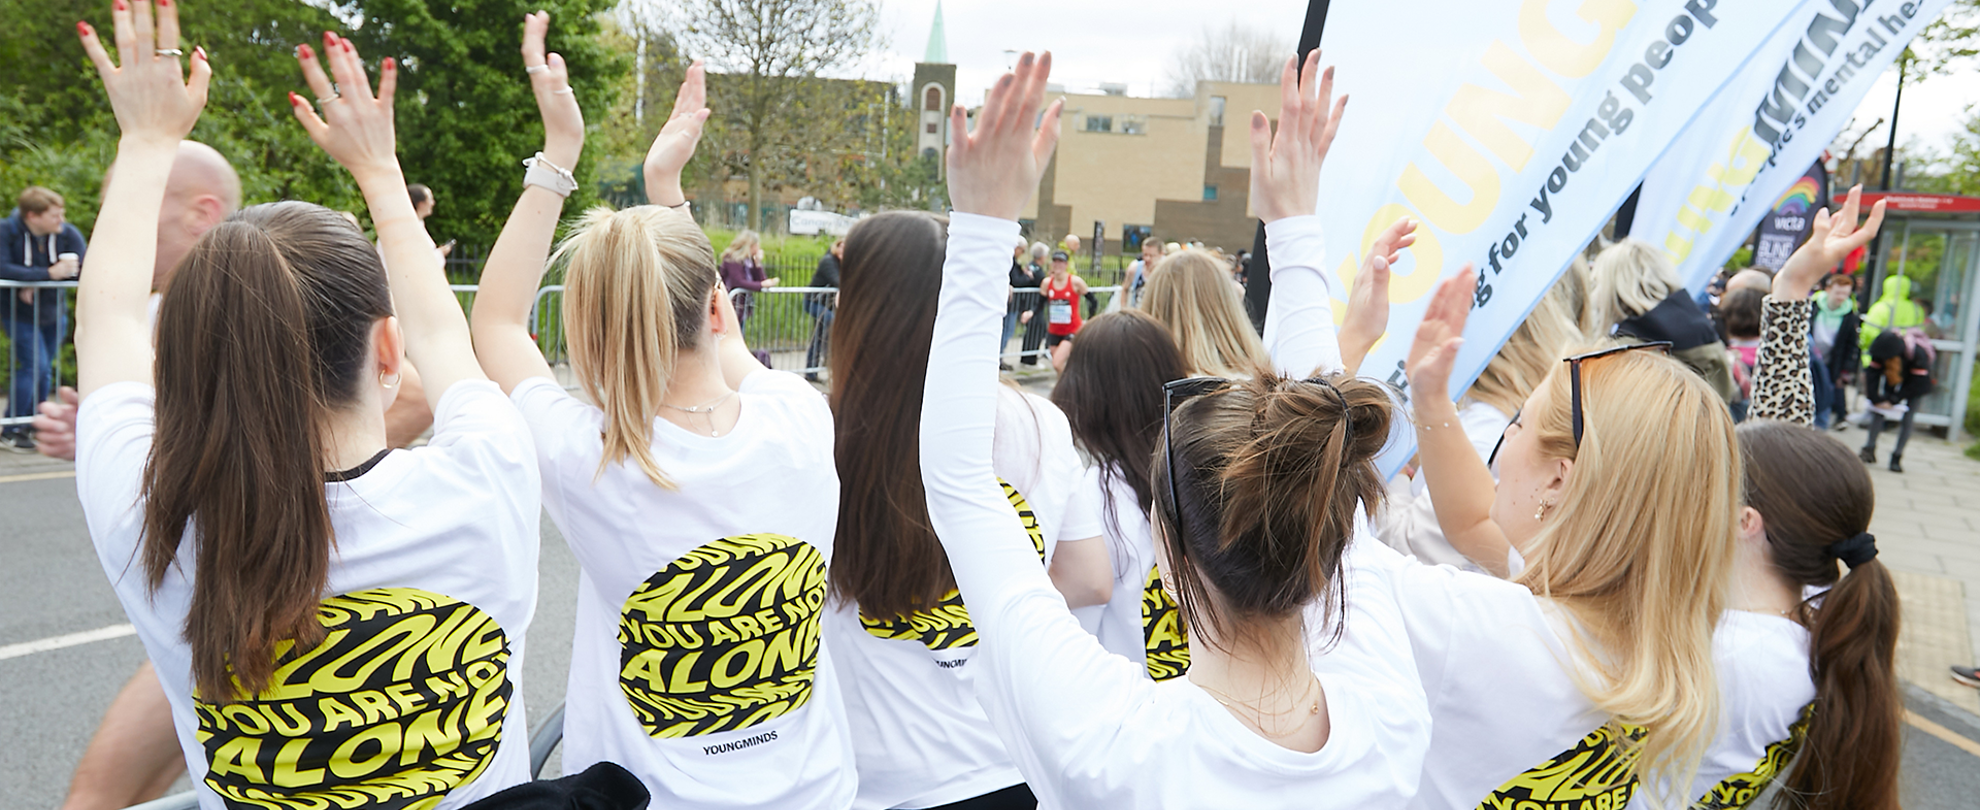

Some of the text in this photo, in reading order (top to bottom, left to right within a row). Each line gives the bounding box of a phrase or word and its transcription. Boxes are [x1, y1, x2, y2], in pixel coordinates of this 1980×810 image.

[1807, 0, 1923, 115] mental he
[1488, 212, 1529, 275] for
[1530, 89, 1634, 224] young
[620, 614, 704, 649] YOU
[707, 608, 784, 647] ARE
[620, 610, 823, 694] ALONE
[209, 668, 507, 788] ALONE
[318, 683, 428, 733] ARE
[702, 730, 778, 756] YOUNGMINDS
